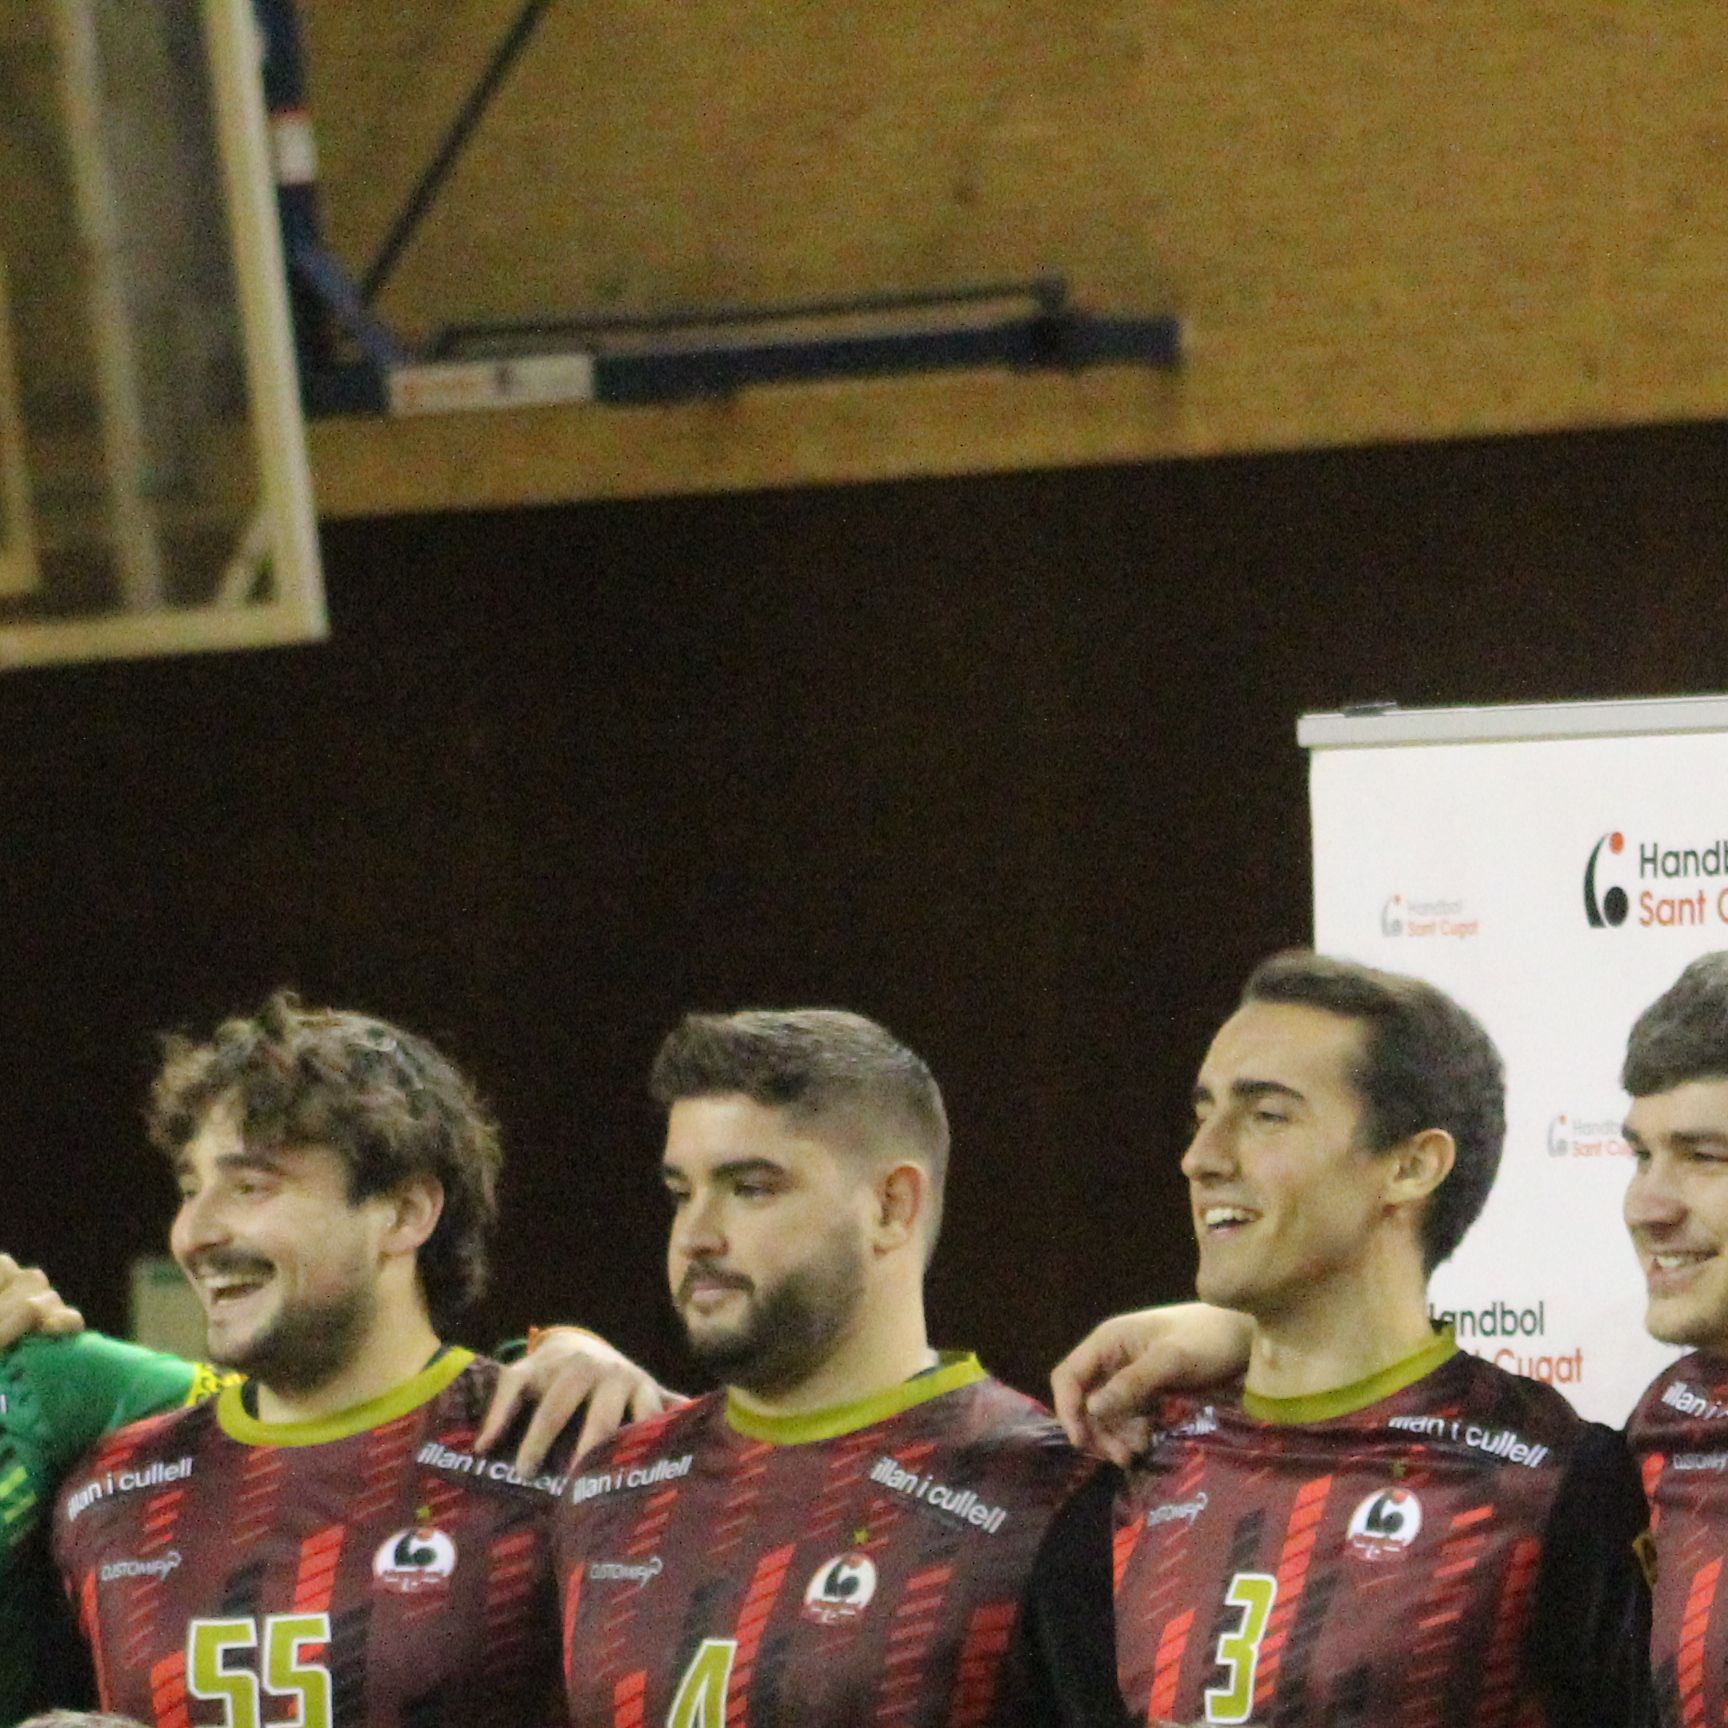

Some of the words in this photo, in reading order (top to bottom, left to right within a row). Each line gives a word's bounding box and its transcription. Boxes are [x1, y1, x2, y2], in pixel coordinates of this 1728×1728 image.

[1640, 889, 1706, 928] Sant
[1465, 1425, 1549, 1468] cullell
[118, 1456, 193, 1491] cullell
[626, 1454, 693, 1489] cullell
[871, 1456, 918, 1496] illan
[925, 1485, 1008, 1535] cullell
[1204, 1572, 1278, 1725] 3
